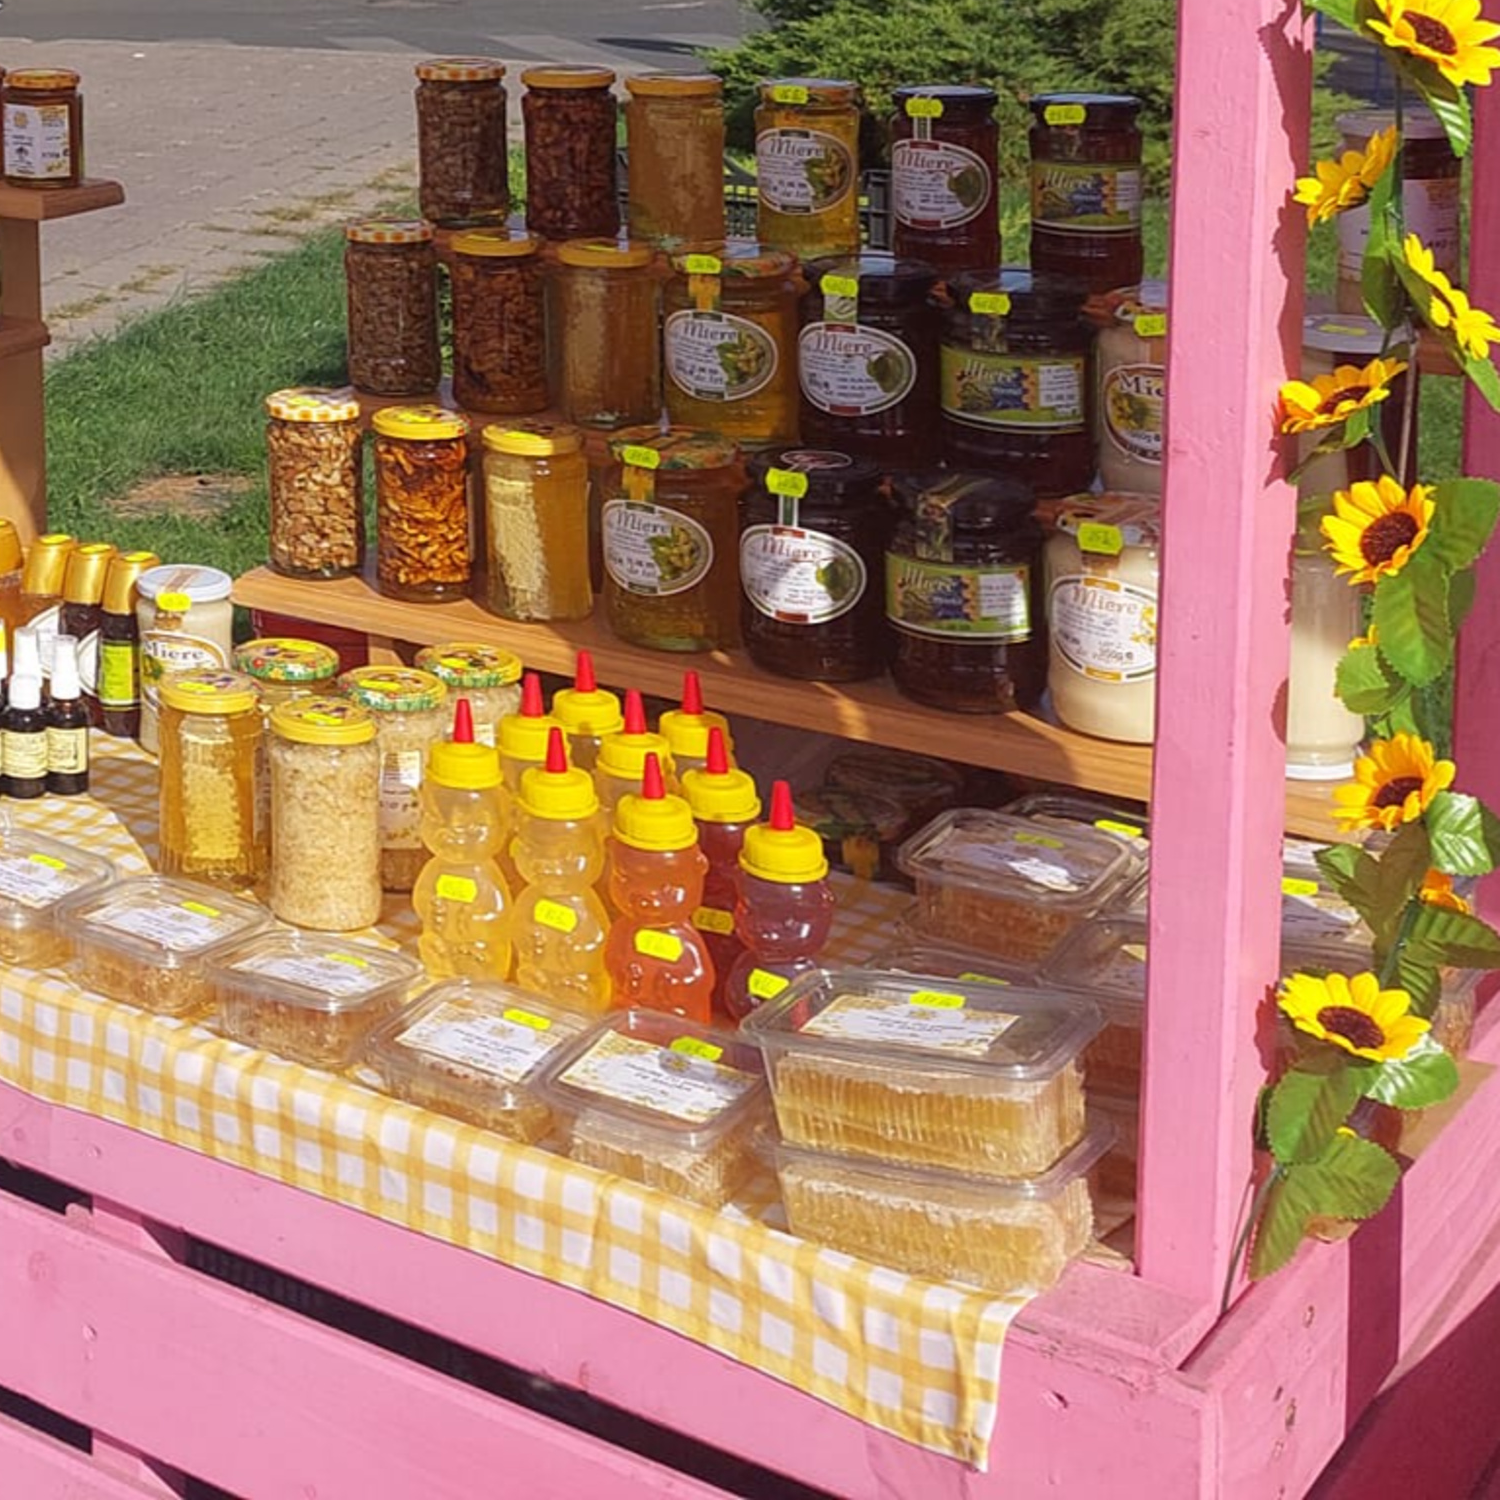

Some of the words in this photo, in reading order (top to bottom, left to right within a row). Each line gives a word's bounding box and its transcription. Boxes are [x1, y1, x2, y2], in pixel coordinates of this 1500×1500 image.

[769, 137, 823, 158] Miere
[900, 150, 954, 169] Miere
[682, 320, 737, 342] Miere
[815, 333, 873, 355] Miere
[616, 509, 669, 536] Miere
[761, 534, 822, 559] Miere
[1071, 585, 1138, 616] Miere
[144, 641, 204, 660] Miere
